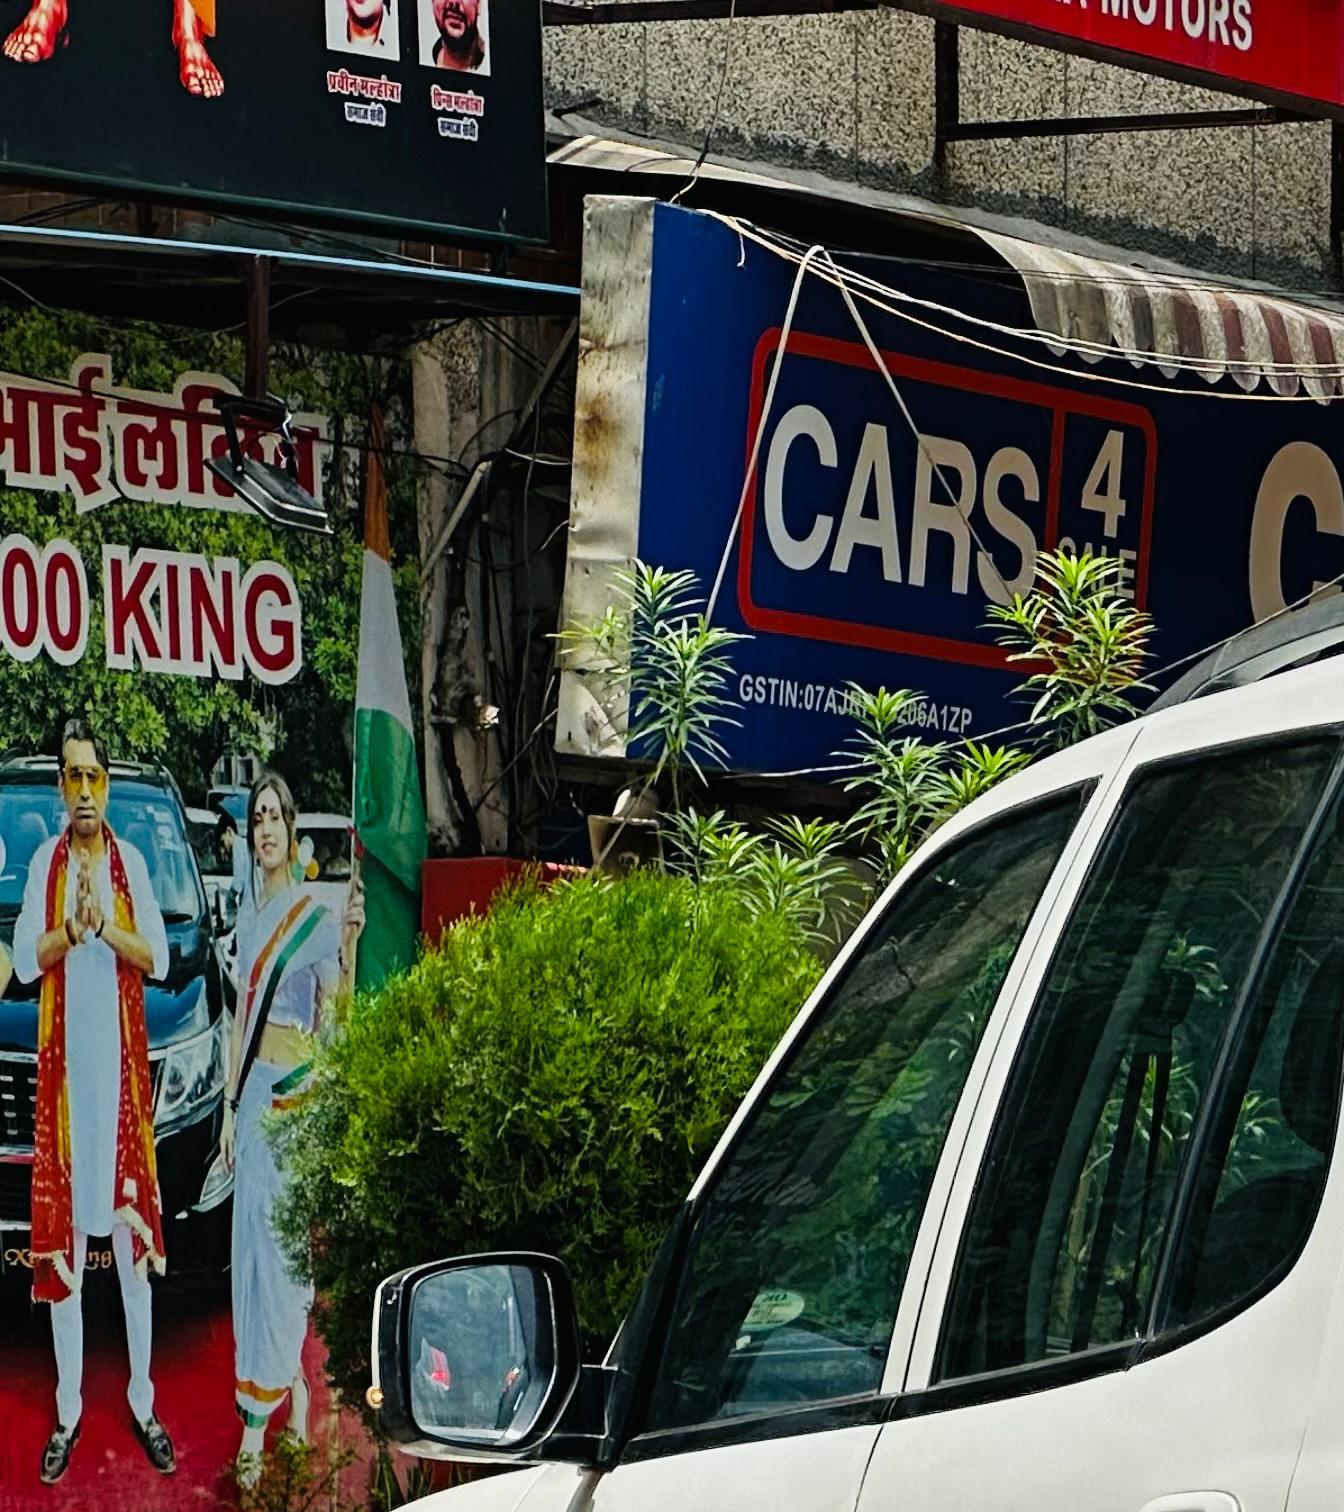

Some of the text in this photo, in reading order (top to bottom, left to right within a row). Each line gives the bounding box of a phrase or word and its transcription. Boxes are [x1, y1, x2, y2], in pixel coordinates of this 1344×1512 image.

[763, 404, 1127, 607] CARS 4
[110, 557, 296, 672] KING
